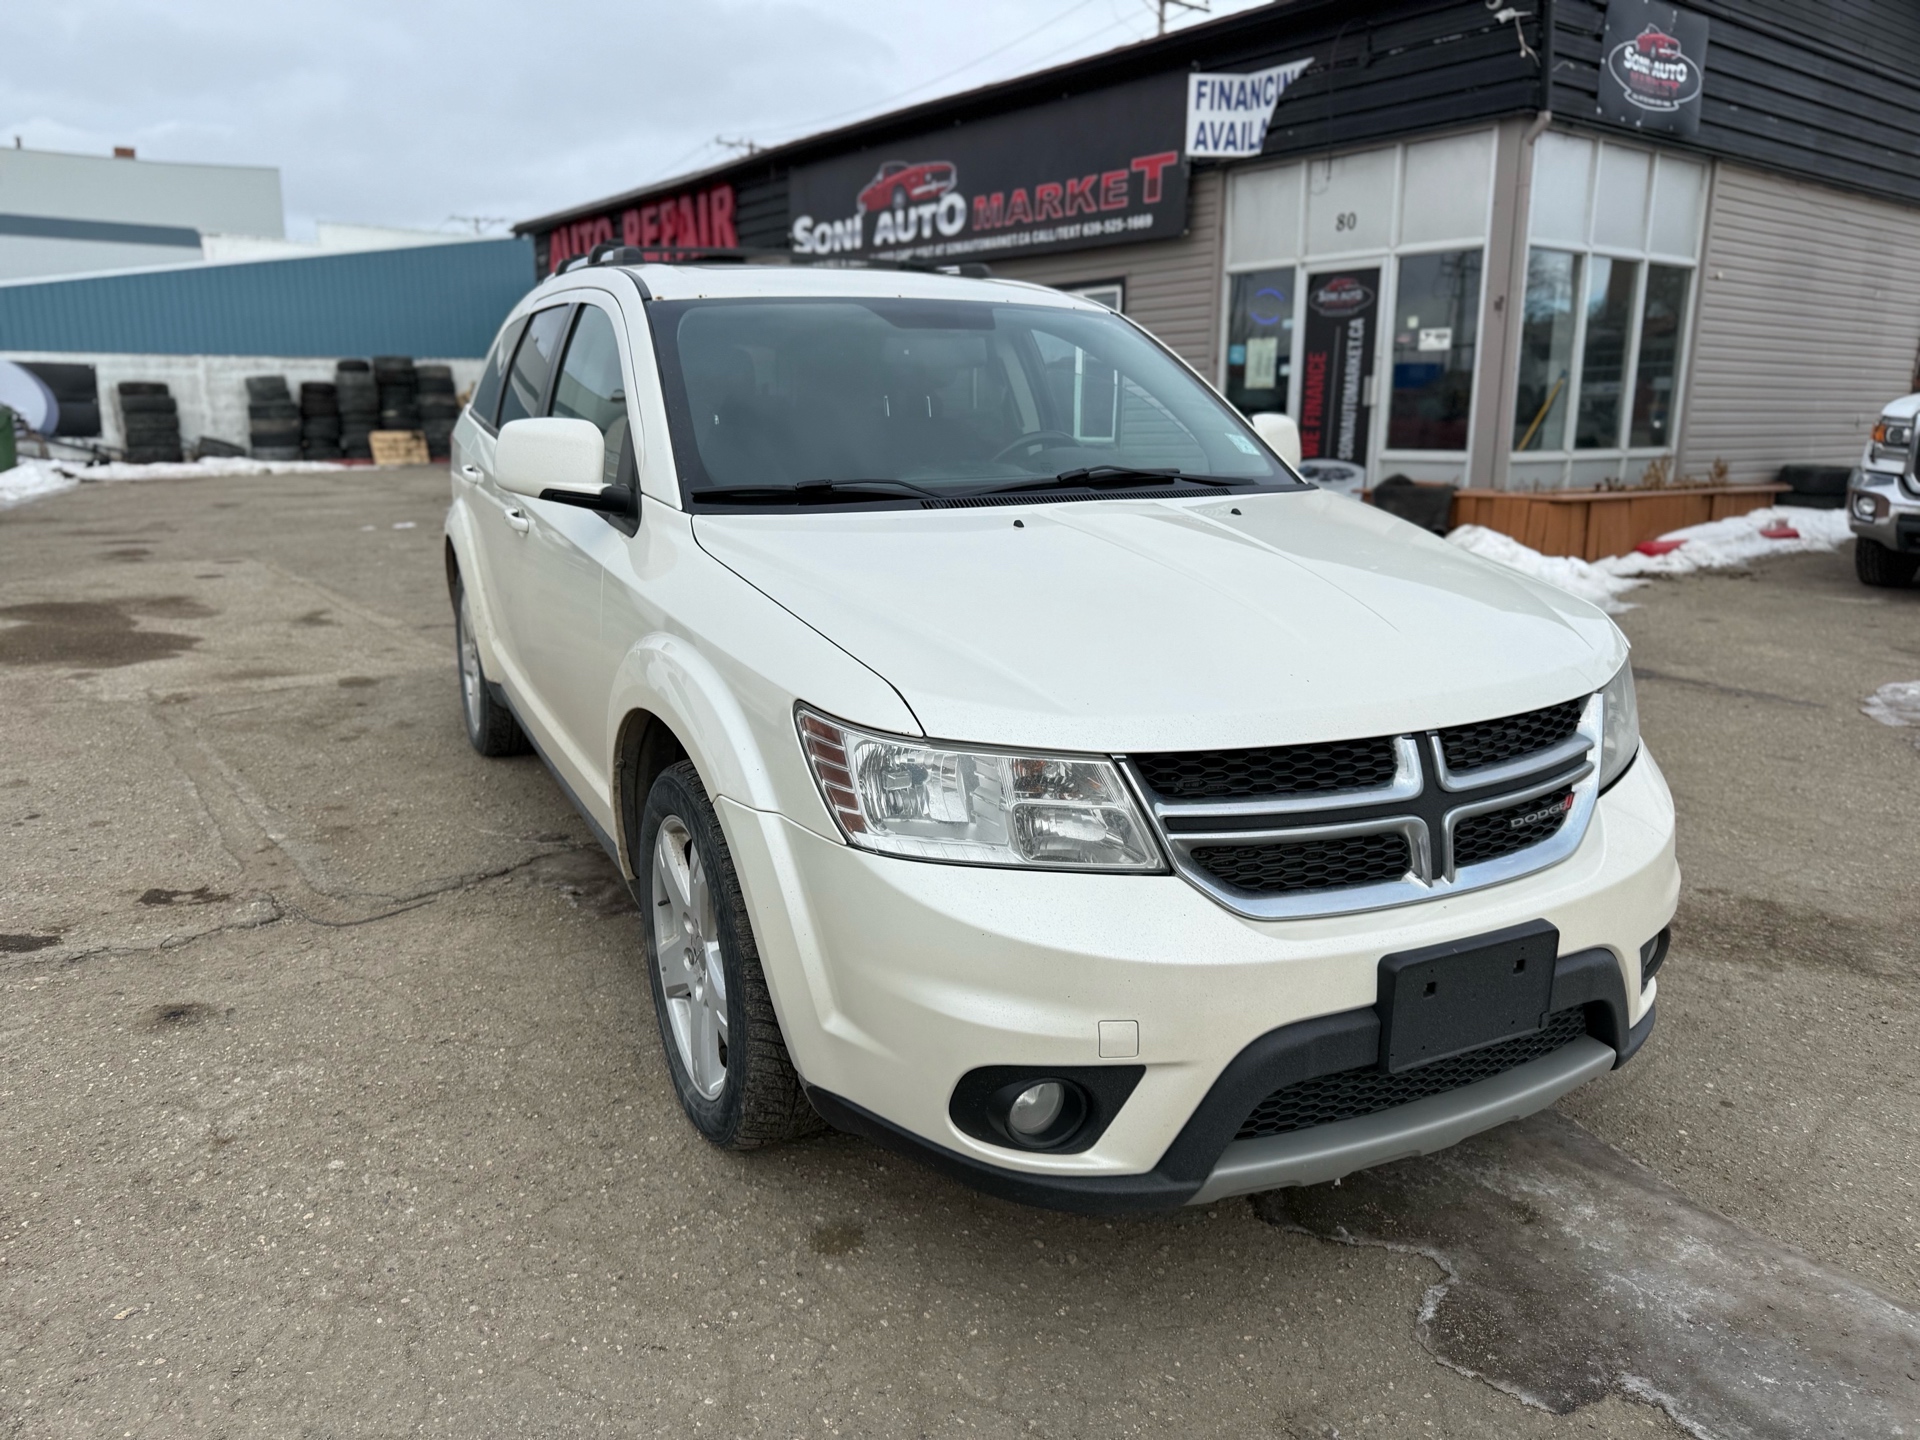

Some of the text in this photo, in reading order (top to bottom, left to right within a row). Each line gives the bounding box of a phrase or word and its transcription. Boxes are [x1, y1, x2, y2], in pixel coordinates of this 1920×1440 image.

[622, 184, 738, 262] REPAIR
[873, 194, 967, 246] AUTO
[973, 151, 1178, 230] MARKET
[1335, 211, 1357, 232] 80
[1302, 352, 1327, 458] WE FINANCE
[1338, 317, 1365, 460] SONIAUTOMARKET.CA
[1510, 800, 1567, 828] DODGE
